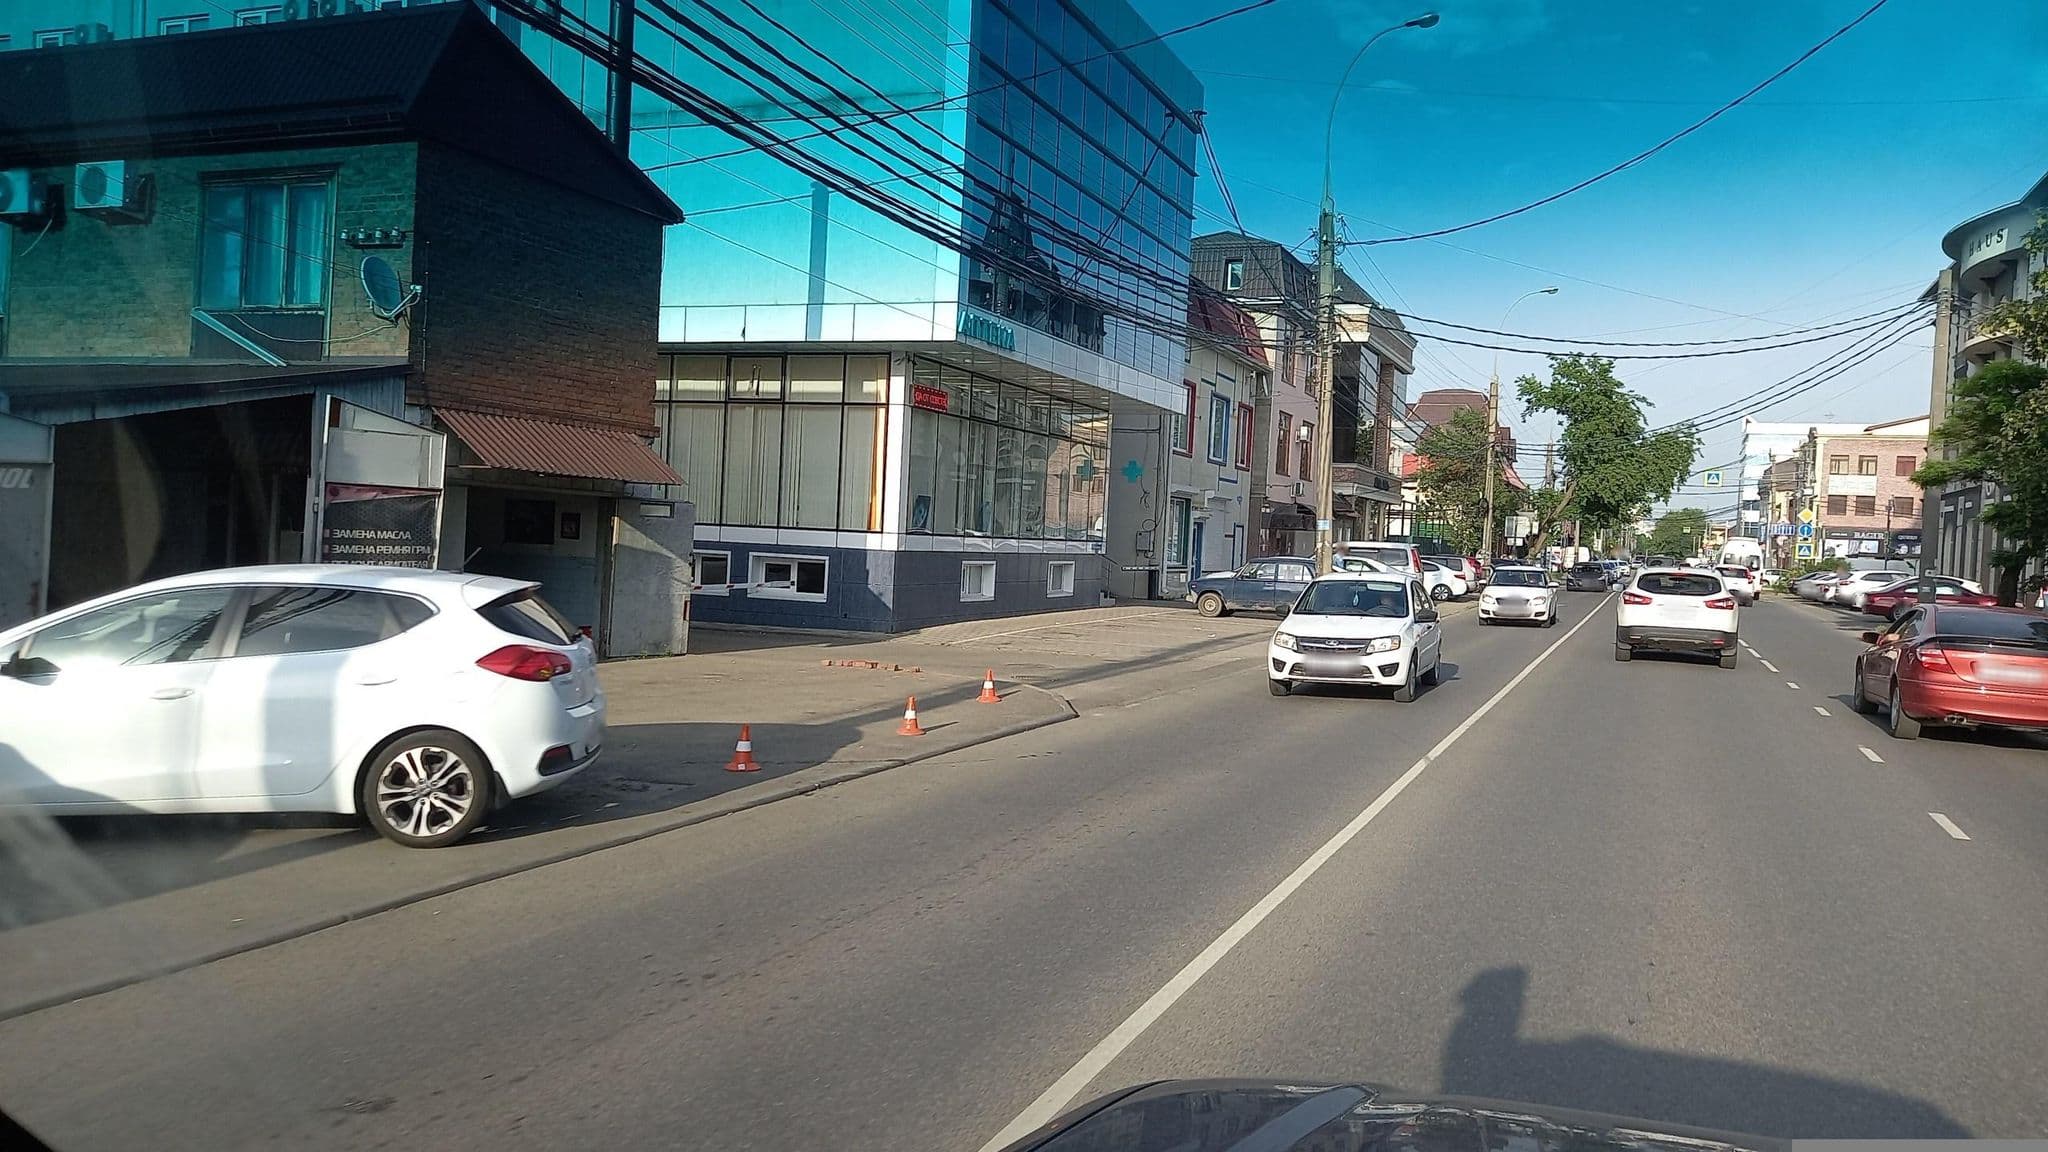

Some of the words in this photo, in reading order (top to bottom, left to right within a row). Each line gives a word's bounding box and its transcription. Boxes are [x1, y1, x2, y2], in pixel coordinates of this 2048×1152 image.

[331, 529, 376, 540] ЗАМЕНА
[377, 530, 412, 540] МАСЛА
[331, 544, 375, 554] ЗАМЕНА
[376, 545, 411, 554] РЕМНЯ
